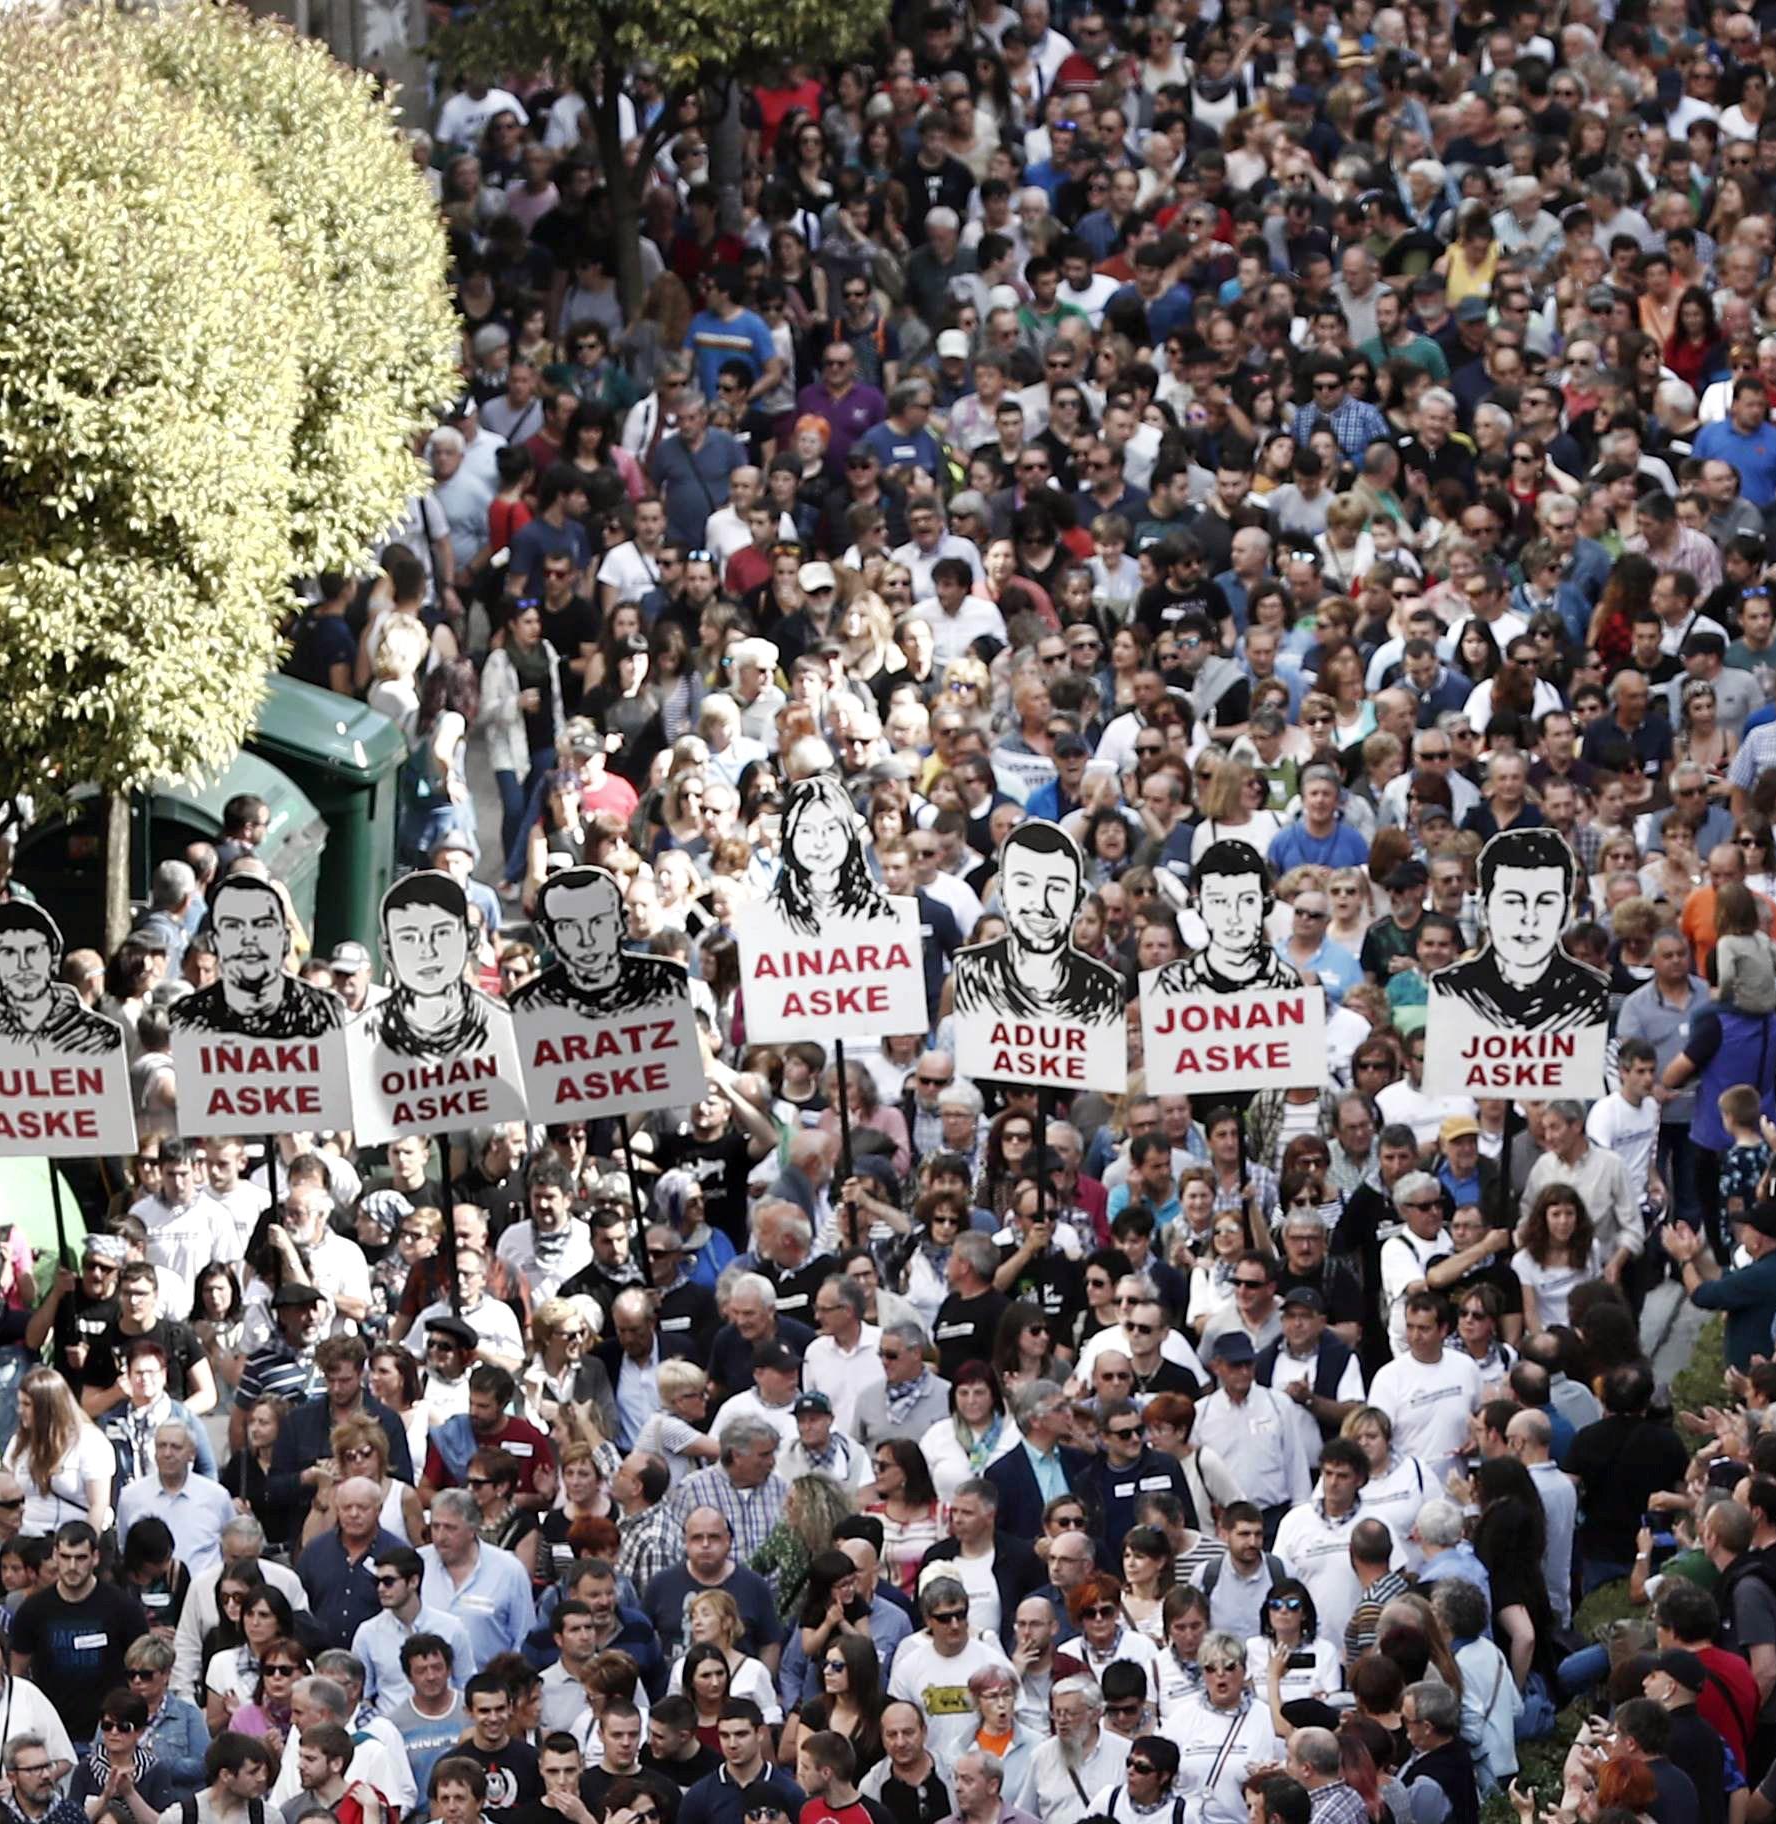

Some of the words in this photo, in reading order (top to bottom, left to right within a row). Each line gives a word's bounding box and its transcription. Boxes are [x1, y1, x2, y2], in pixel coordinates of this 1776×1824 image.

[754, 943, 911, 979] AINARA
[781, 985, 890, 1017] ASKE
[1154, 998, 1305, 1035] JONAN
[532, 1020, 678, 1067] ARATZ
[990, 1021, 1087, 1052] ADUR
[1460, 1033, 1575, 1060] JOKIN
[199, 1040, 319, 1074] IÑAKI
[993, 1050, 1085, 1080] ASKE
[1174, 1042, 1291, 1074] ASKE
[381, 1055, 498, 1096] OIHAN
[554, 1063, 670, 1105] ASKE
[1465, 1062, 1563, 1087] ASKE
[206, 1086, 322, 1116] ASKE
[391, 1089, 489, 1126] ASKE
